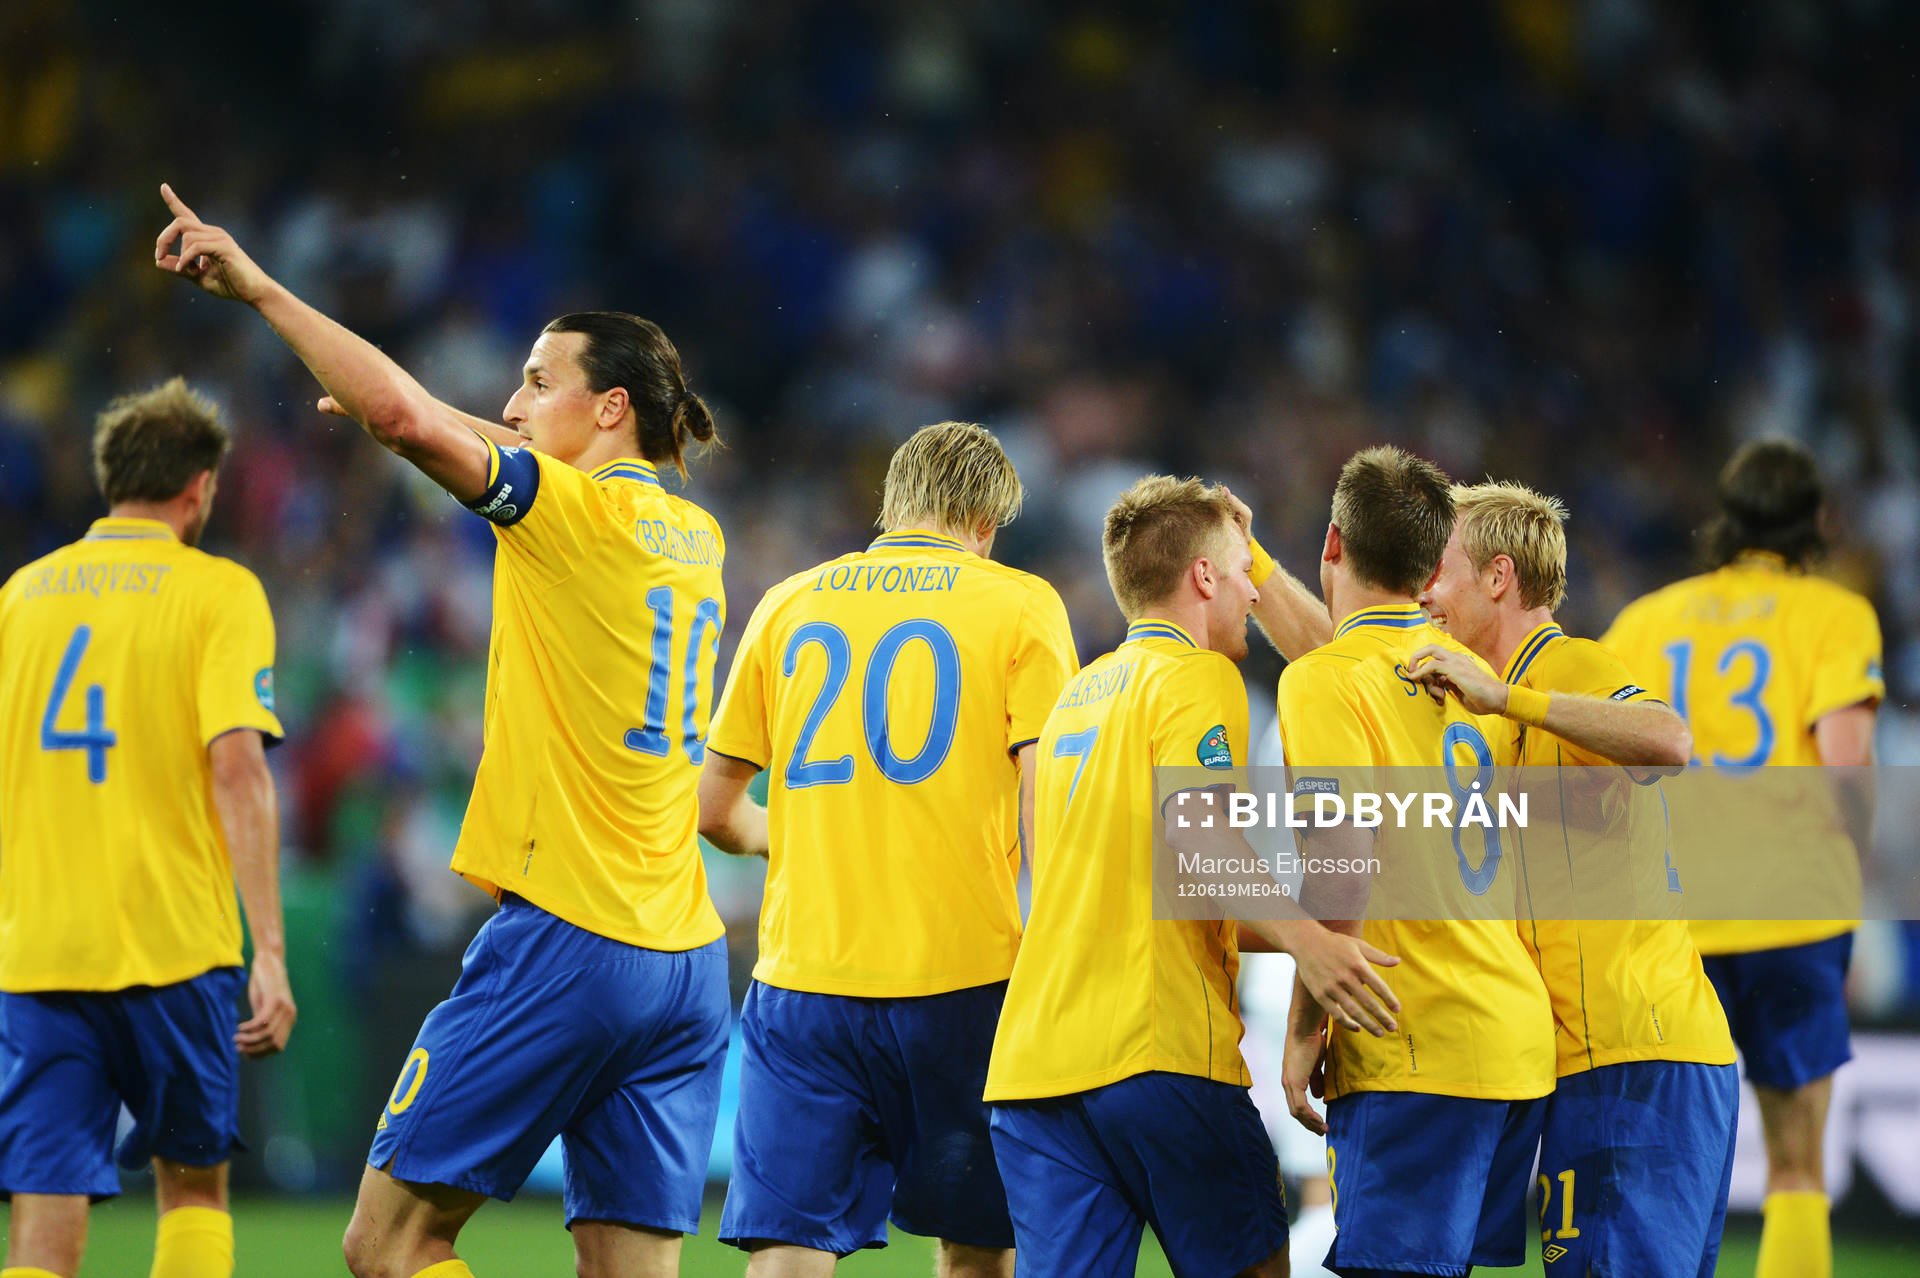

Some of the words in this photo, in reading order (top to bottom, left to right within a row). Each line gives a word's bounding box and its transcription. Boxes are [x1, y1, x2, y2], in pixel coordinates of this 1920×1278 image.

[25, 563, 171, 599] GRANQVIST
[813, 565, 961, 592] TOIVONEN
[41, 625, 117, 784] 4
[623, 585, 722, 766] 10
[783, 618, 962, 790] 20
[1664, 638, 1776, 776] 13
[1053, 726, 1099, 812] 7
[1295, 780, 1337, 793] RESPECT
[1443, 721, 1502, 896] 8
[1536, 1169, 1580, 1242] 21
